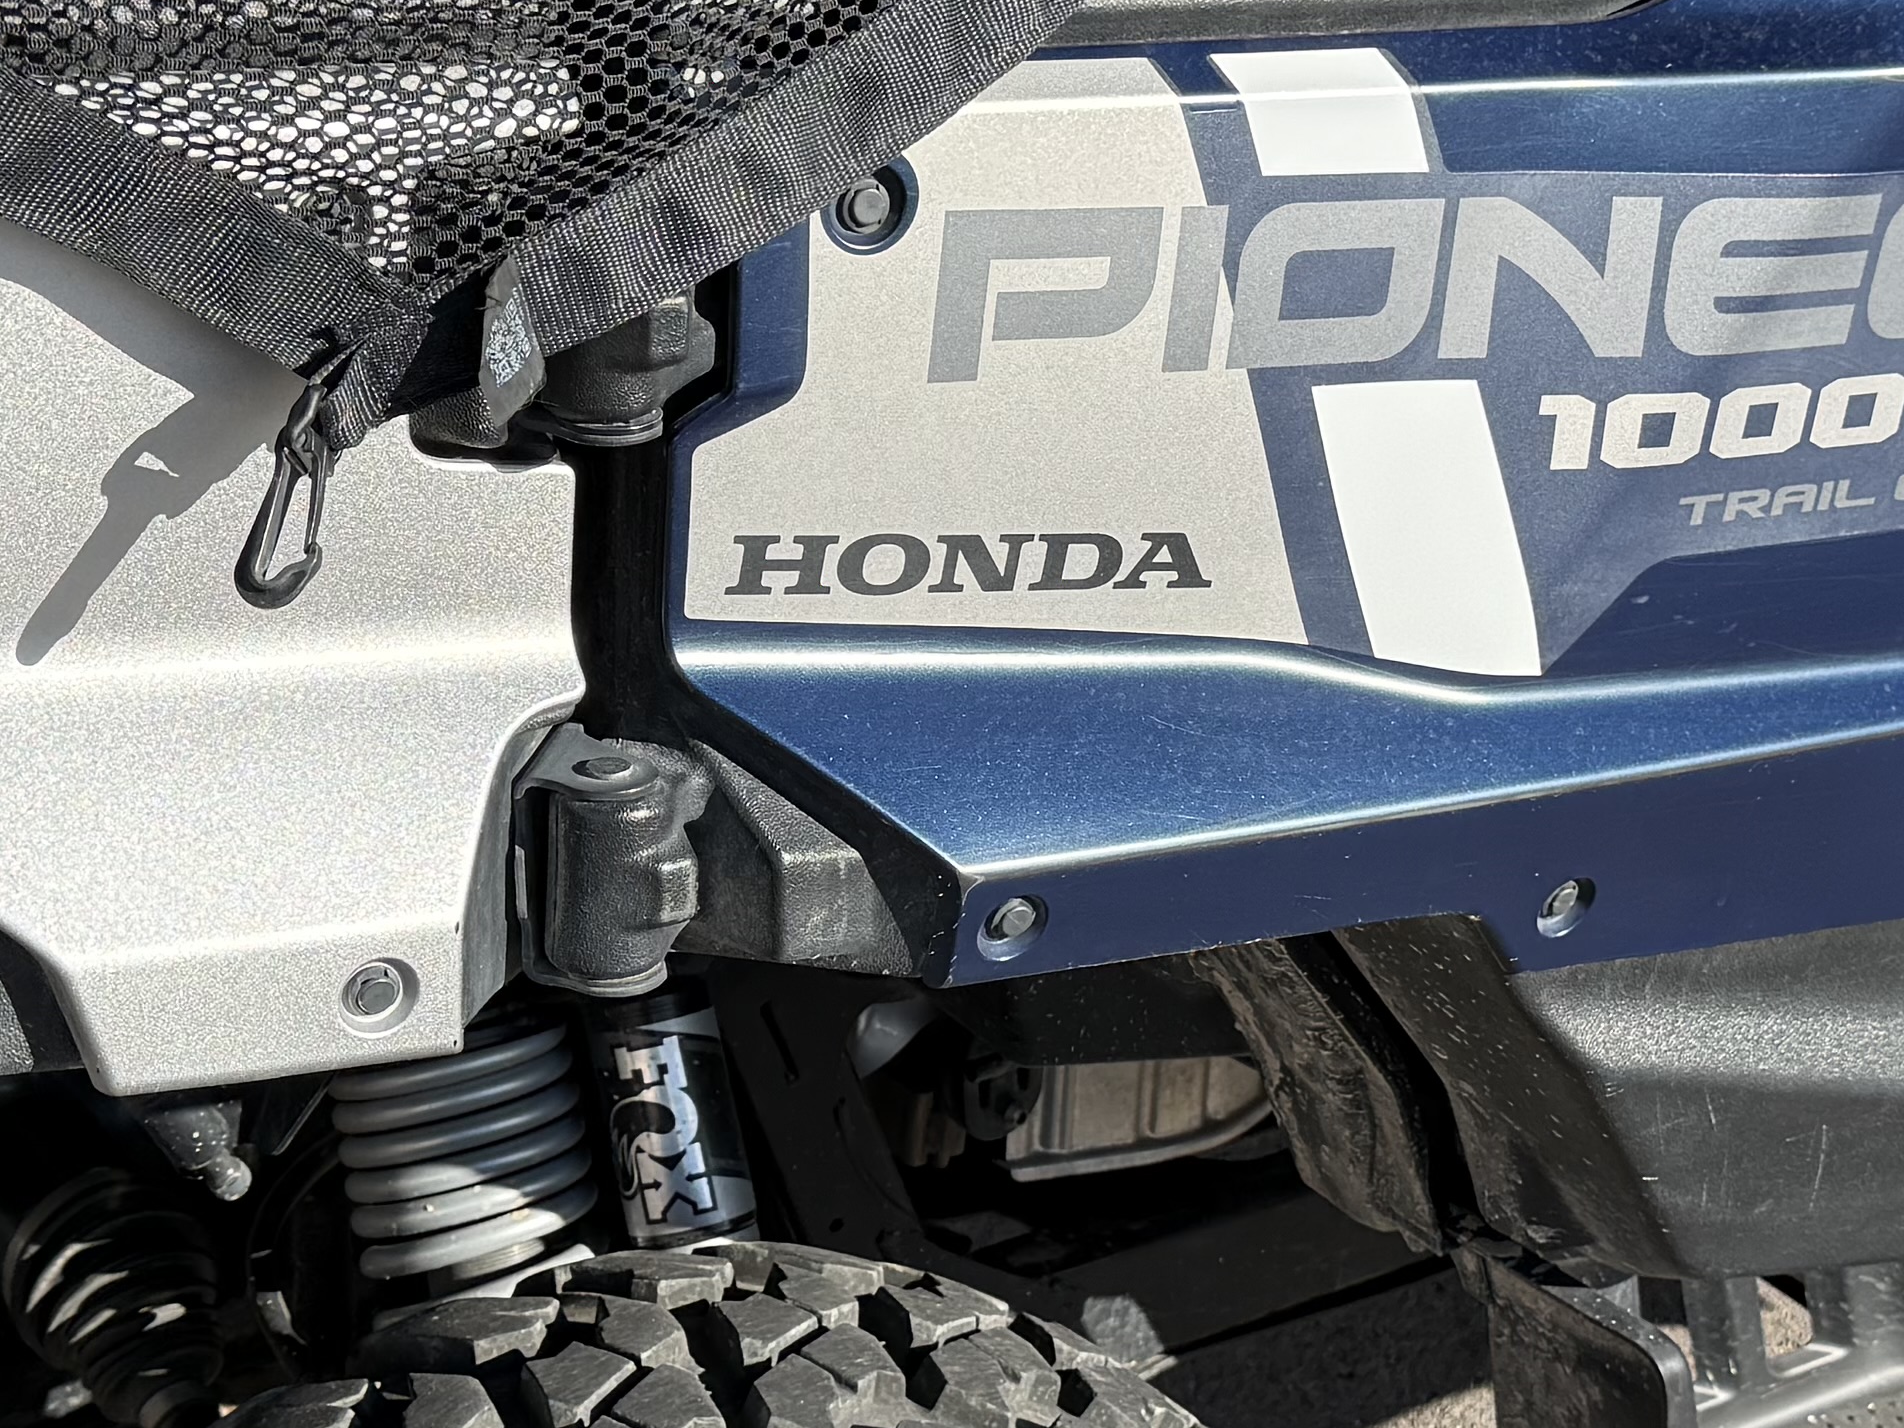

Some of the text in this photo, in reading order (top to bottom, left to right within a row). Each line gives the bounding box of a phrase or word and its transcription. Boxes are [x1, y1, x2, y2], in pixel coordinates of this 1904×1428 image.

[1678, 478, 1876, 526] TRAIL
[723, 531, 1213, 596] HONDA
[610, 1034, 718, 1225] FOX
